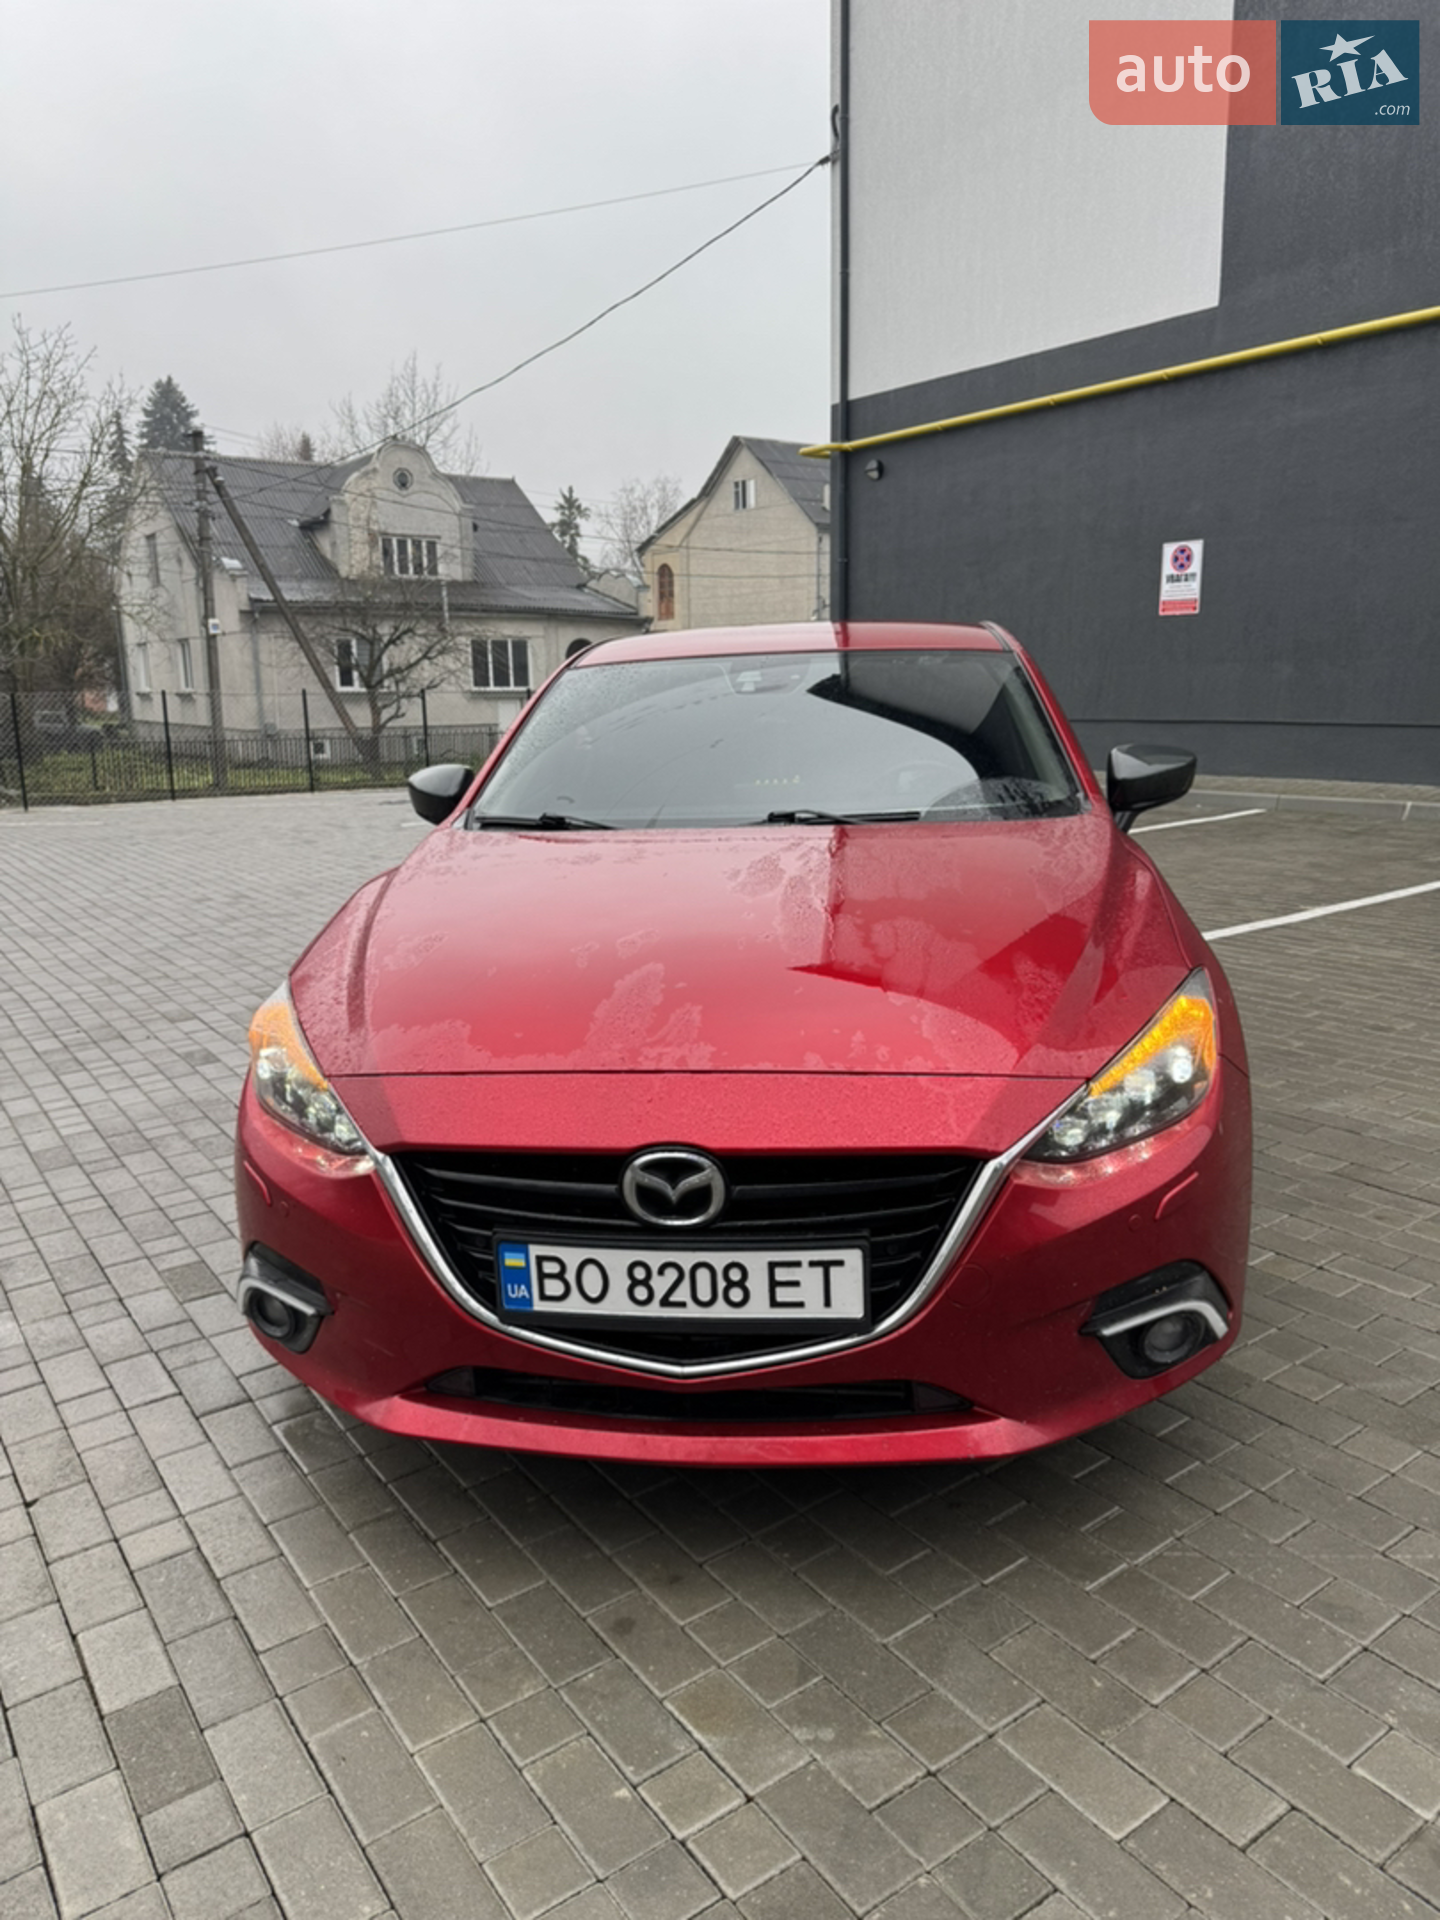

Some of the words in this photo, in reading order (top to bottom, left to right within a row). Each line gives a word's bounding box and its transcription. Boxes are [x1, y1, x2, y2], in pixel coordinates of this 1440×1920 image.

[507, 1284, 530, 1299] UA
[535, 1255, 609, 1304] BO
[626, 1260, 751, 1308] 8208
[767, 1259, 845, 1308] ET
